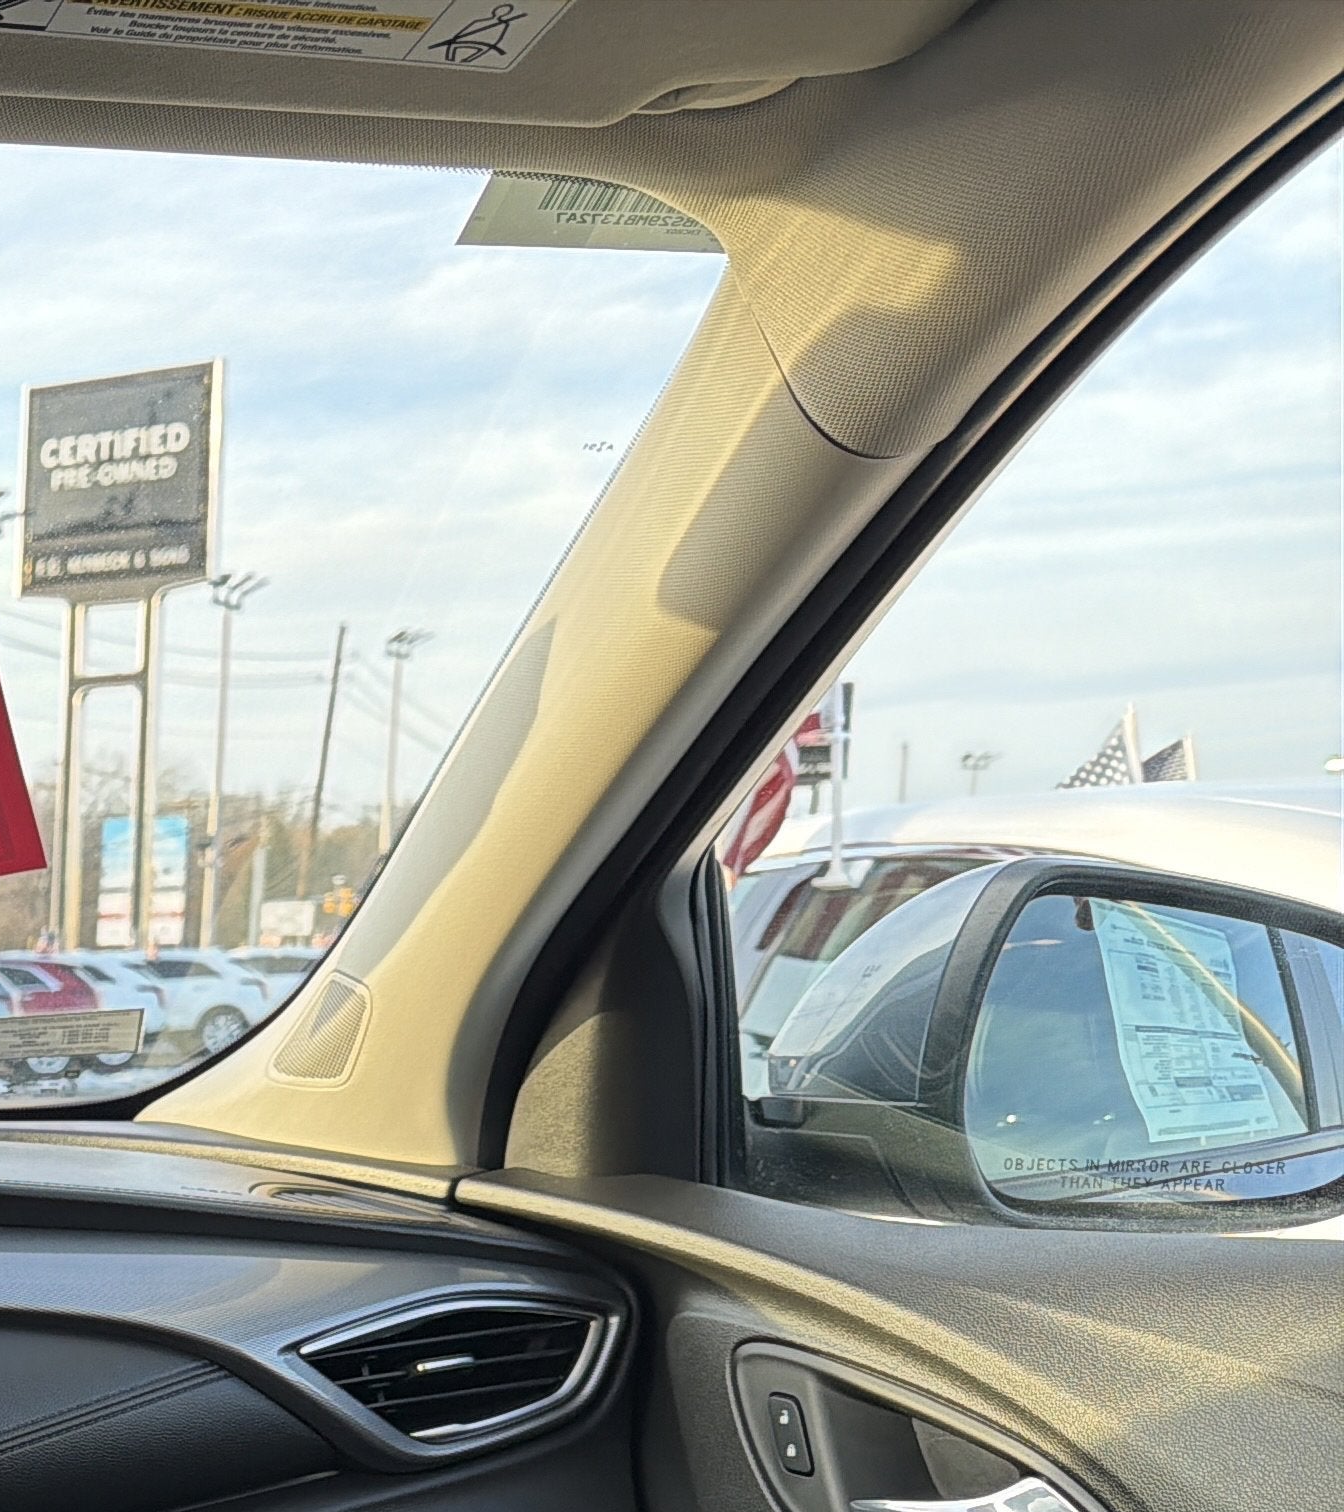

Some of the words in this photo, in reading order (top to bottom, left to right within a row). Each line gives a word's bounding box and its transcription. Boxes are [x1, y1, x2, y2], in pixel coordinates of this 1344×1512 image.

[86, 7, 117, 17] Éviter
[120, 10, 135, 18] les
[203, 18, 253, 29] brusques
[255, 22, 267, 30] et
[268, 23, 284, 31] les
[286, 25, 331, 35] vitesses
[128, 20, 170, 31] Boucler
[171, 24, 216, 35] toujours
[230, 29, 274, 39] ceinture
[276, 32, 290, 40] de
[242, 8, 289, 19] RISQUE
[293, 12, 337, 23] ACCRU
[338, 15, 354, 24] DE
[356, 17, 423, 30] CAPOTAGE
[90, 26, 112, 34] Voir
[125, 29, 156, 38] Guide
[158, 32, 172, 40] du
[174, 33, 238, 45] propriétaire
[238, 39, 265, 48] pour
[265, 40, 289, 50] plus
[40, 422, 190, 468] CERTIFIED
[50, 455, 178, 492] PRE-OWNED
[1003, 1157, 1079, 1172] OBJECTS
[1085, 1158, 1100, 1172] IN
[1107, 1159, 1169, 1173] MIRROR
[1179, 1161, 1210, 1175] ARE
[1221, 1161, 1287, 1175] CLOSER
[1059, 1175, 1103, 1189] THAN
[1112, 1175, 1154, 1189] THEY
[1161, 1177, 1226, 1191] APPEAR
